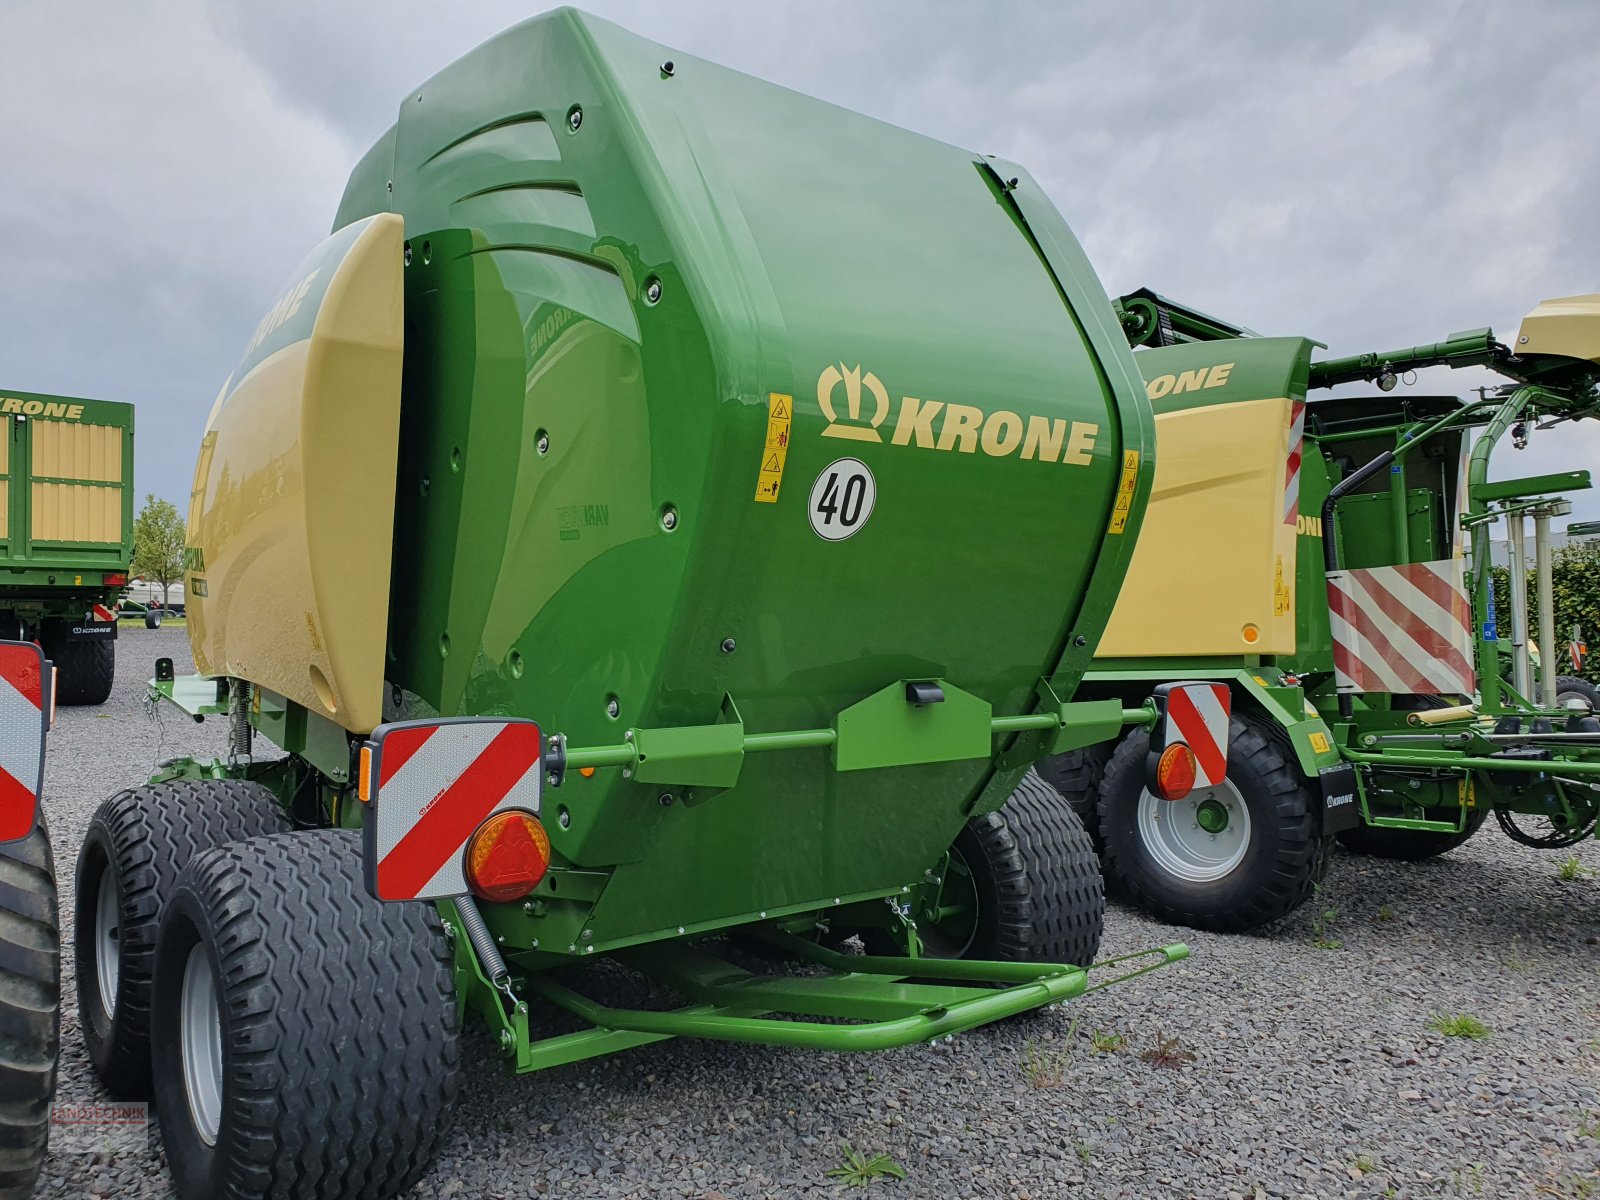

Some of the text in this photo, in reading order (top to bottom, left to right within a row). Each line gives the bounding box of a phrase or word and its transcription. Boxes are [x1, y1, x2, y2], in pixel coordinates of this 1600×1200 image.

[1143, 362, 1235, 400] ONE
[891, 396, 1099, 466] KRONE
[816, 472, 867, 527] 40
